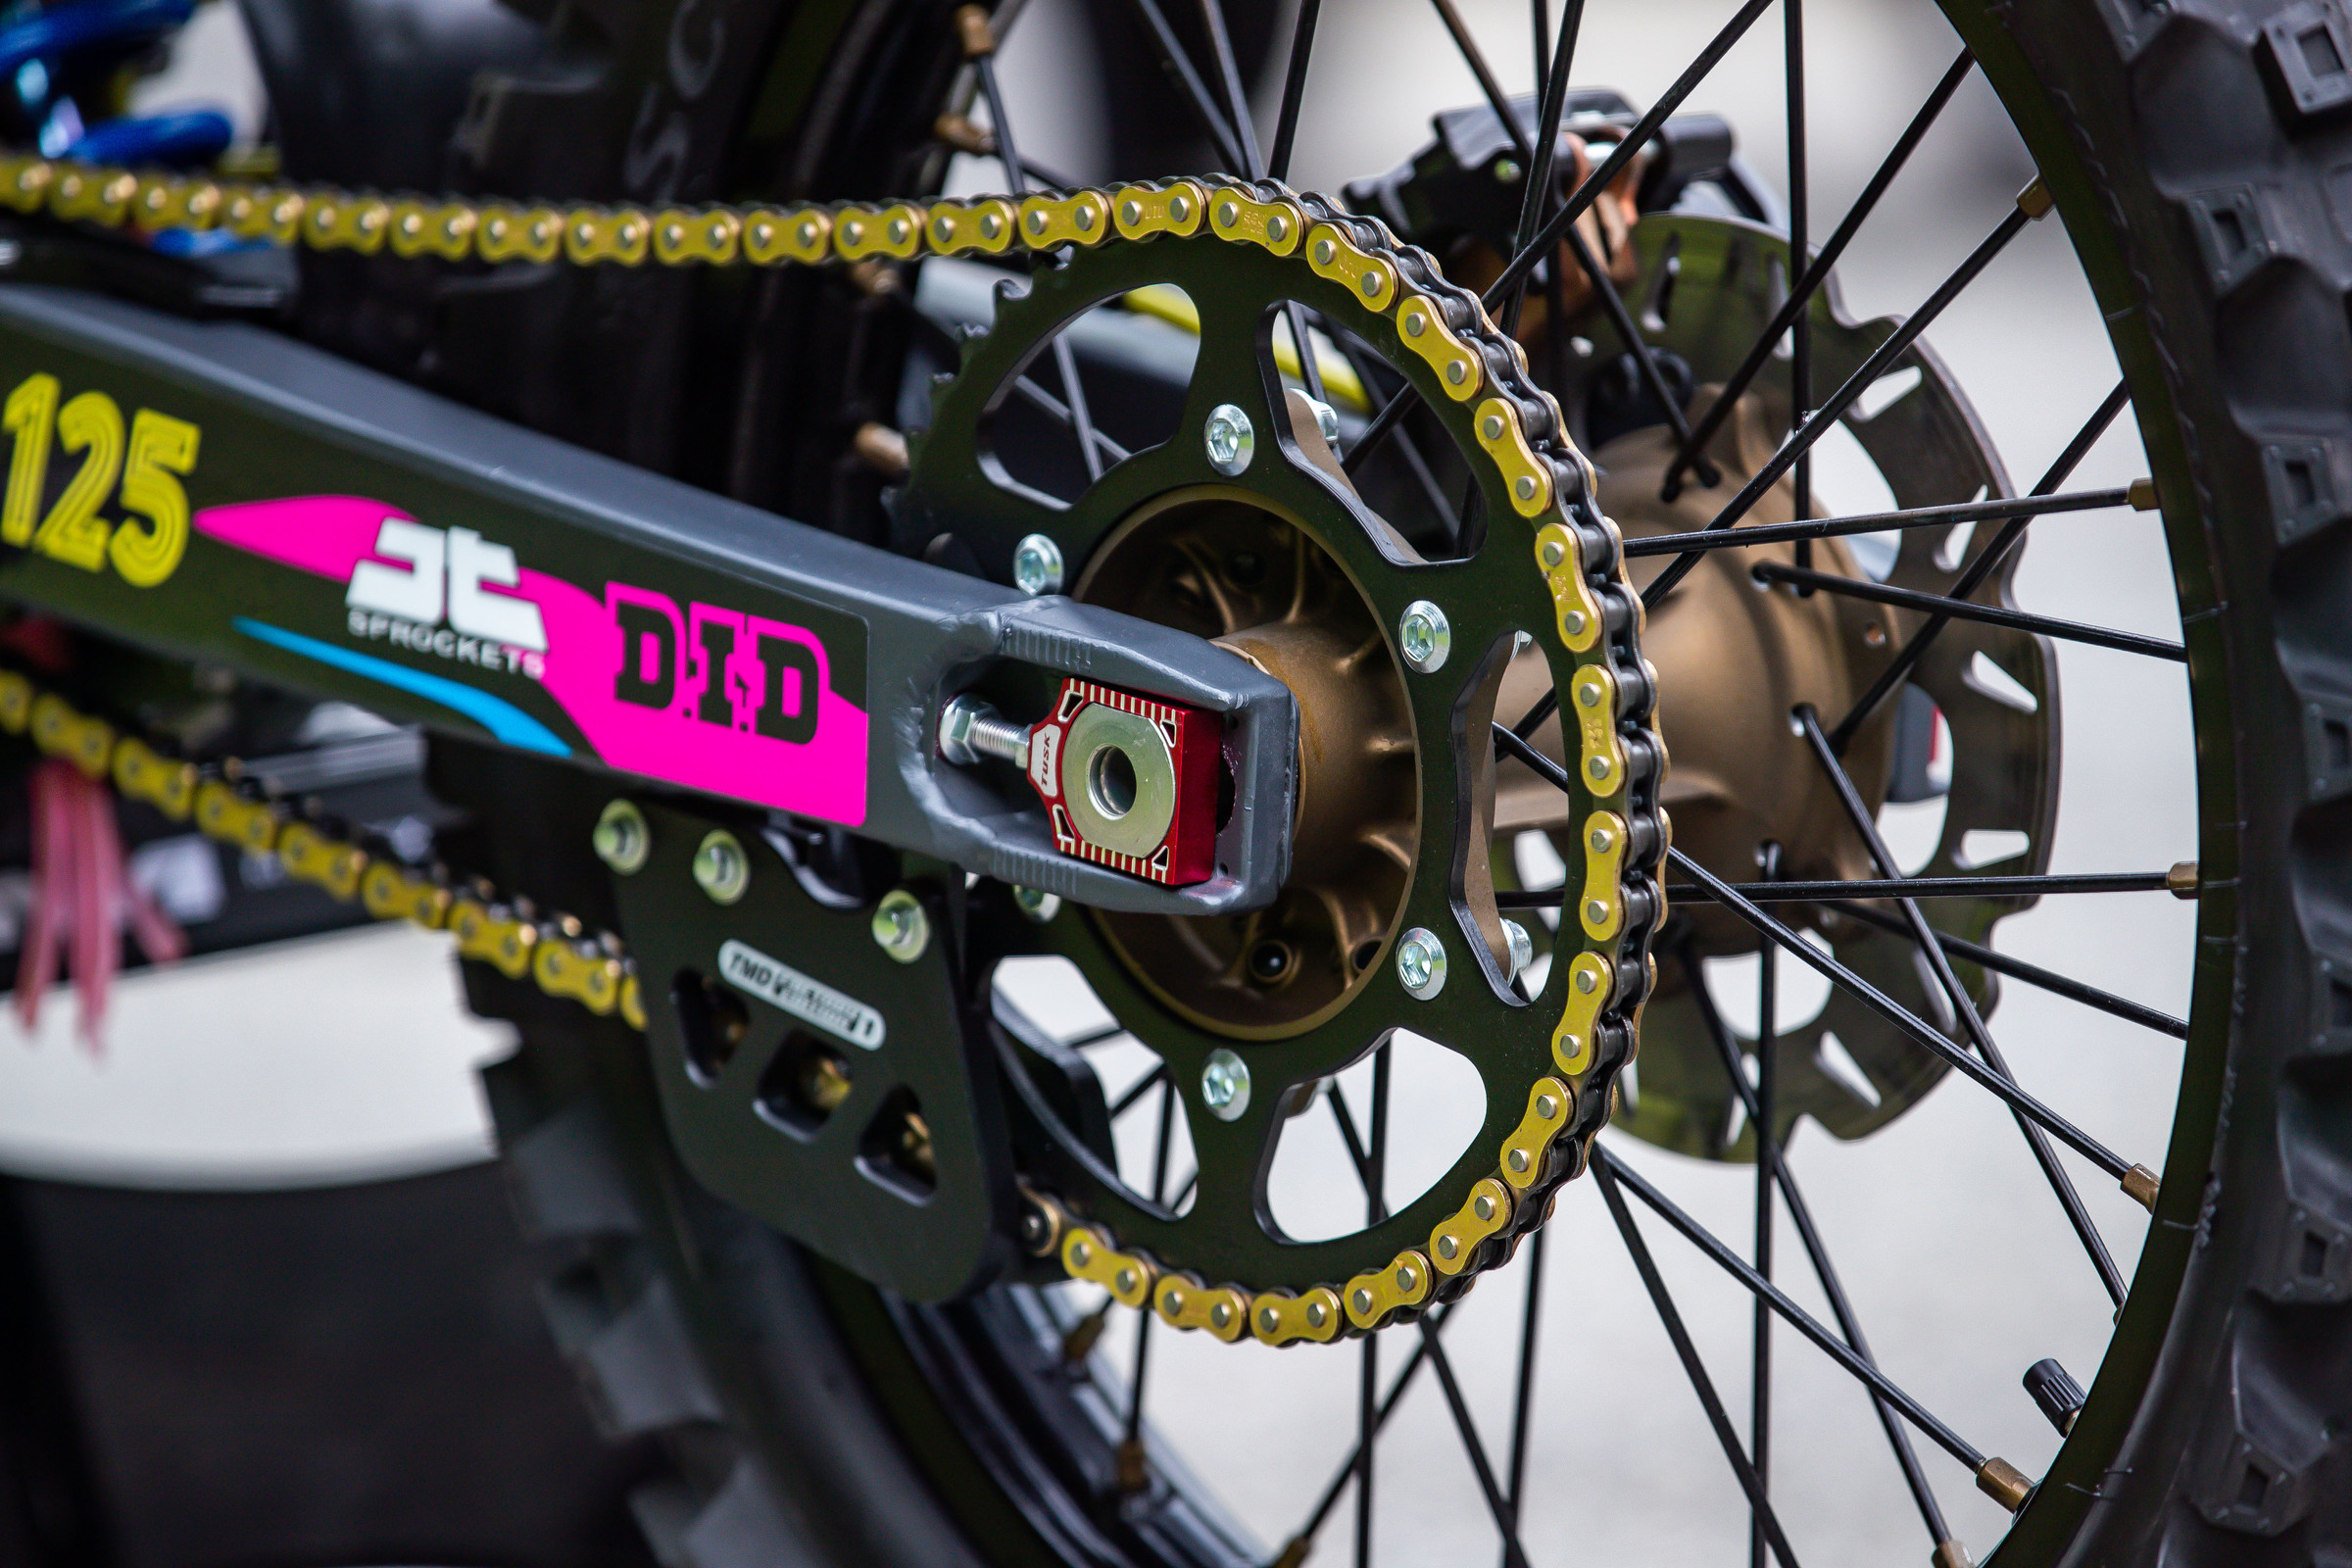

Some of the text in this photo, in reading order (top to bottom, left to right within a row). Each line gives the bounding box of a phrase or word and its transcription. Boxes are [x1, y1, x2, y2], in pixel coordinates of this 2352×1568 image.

[1, 371, 202, 587] 125
[347, 608, 546, 680] SPROCKETS
[1041, 731, 1051, 787] TUSK
